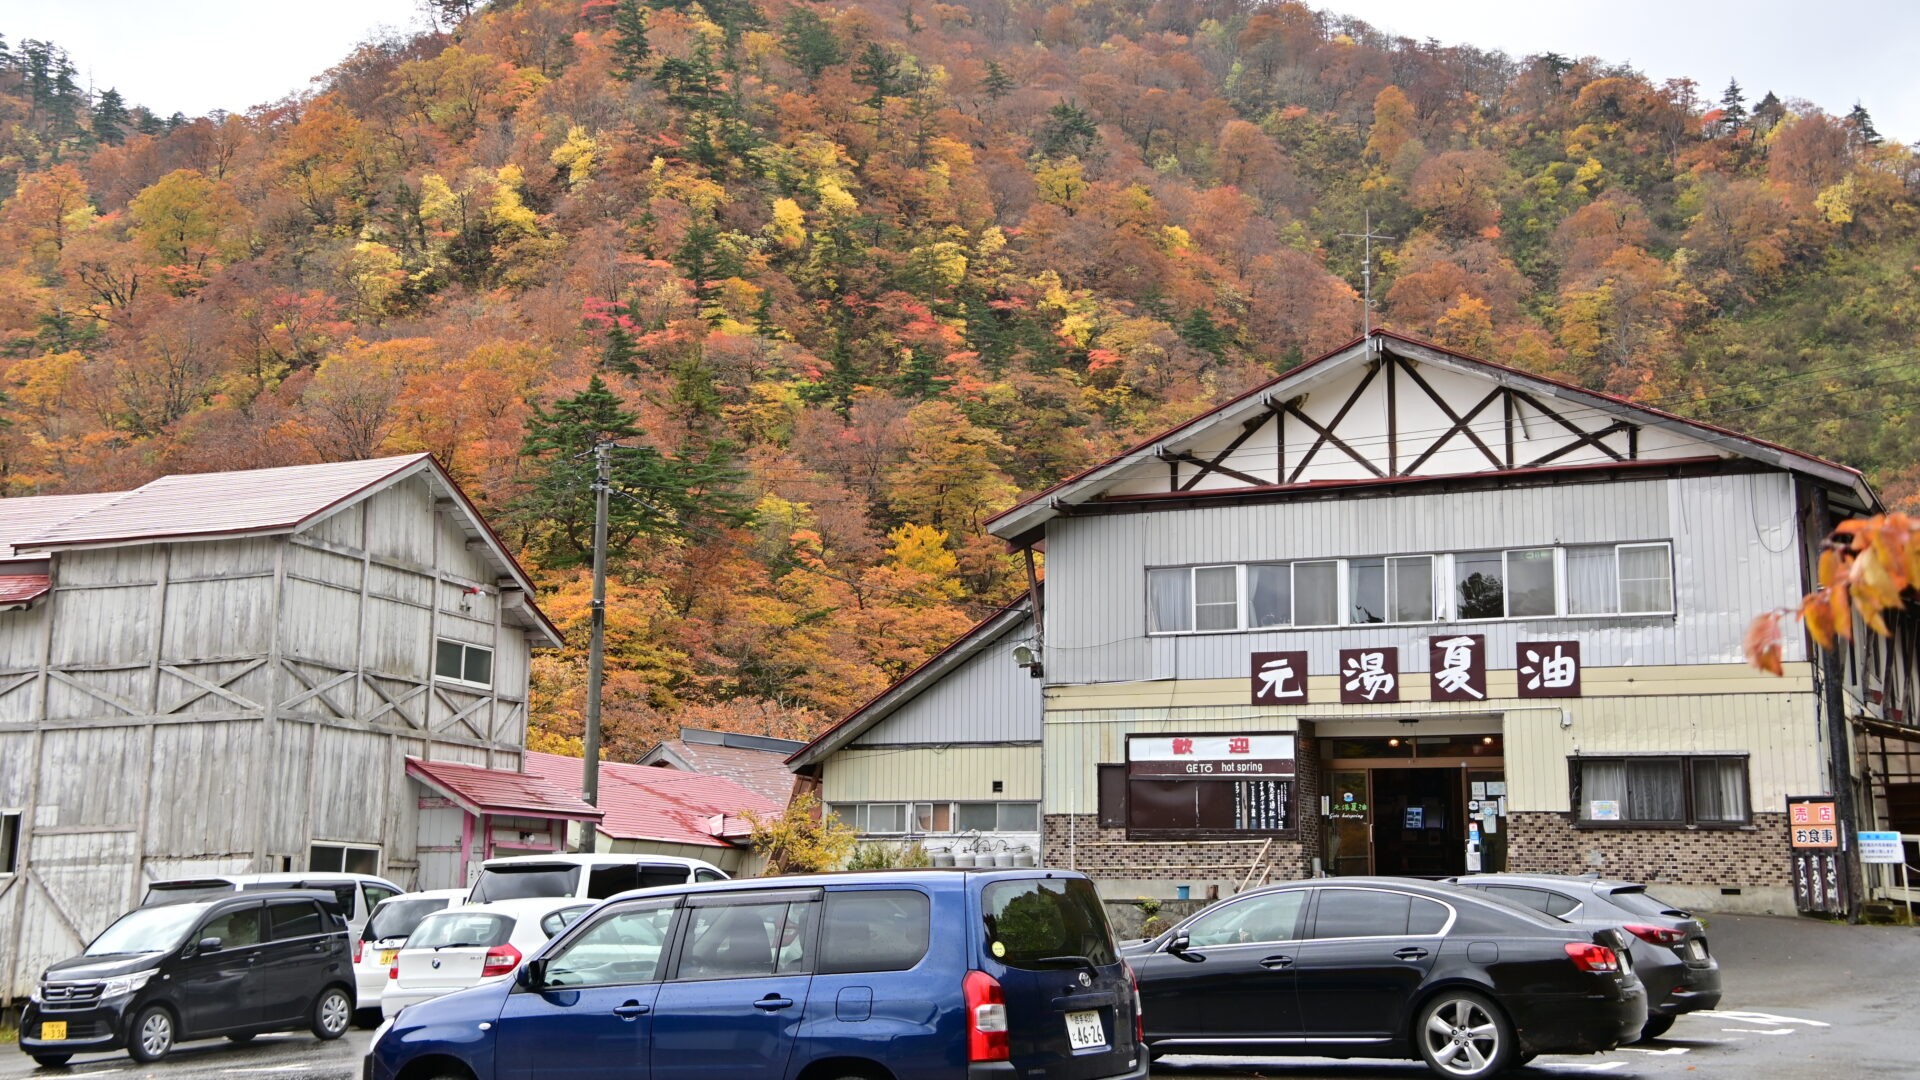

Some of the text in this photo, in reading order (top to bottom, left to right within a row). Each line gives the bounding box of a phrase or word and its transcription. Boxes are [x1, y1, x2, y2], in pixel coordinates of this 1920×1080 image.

[1257, 636, 1576, 701] 元湯夏油
[1221, 762, 1235, 772] hot
[1237, 762, 1263, 772] spring
[1794, 807, 1831, 821] 売店
[1796, 829, 1833, 843] お食事
[1797, 857, 1807, 897] ラーメン
